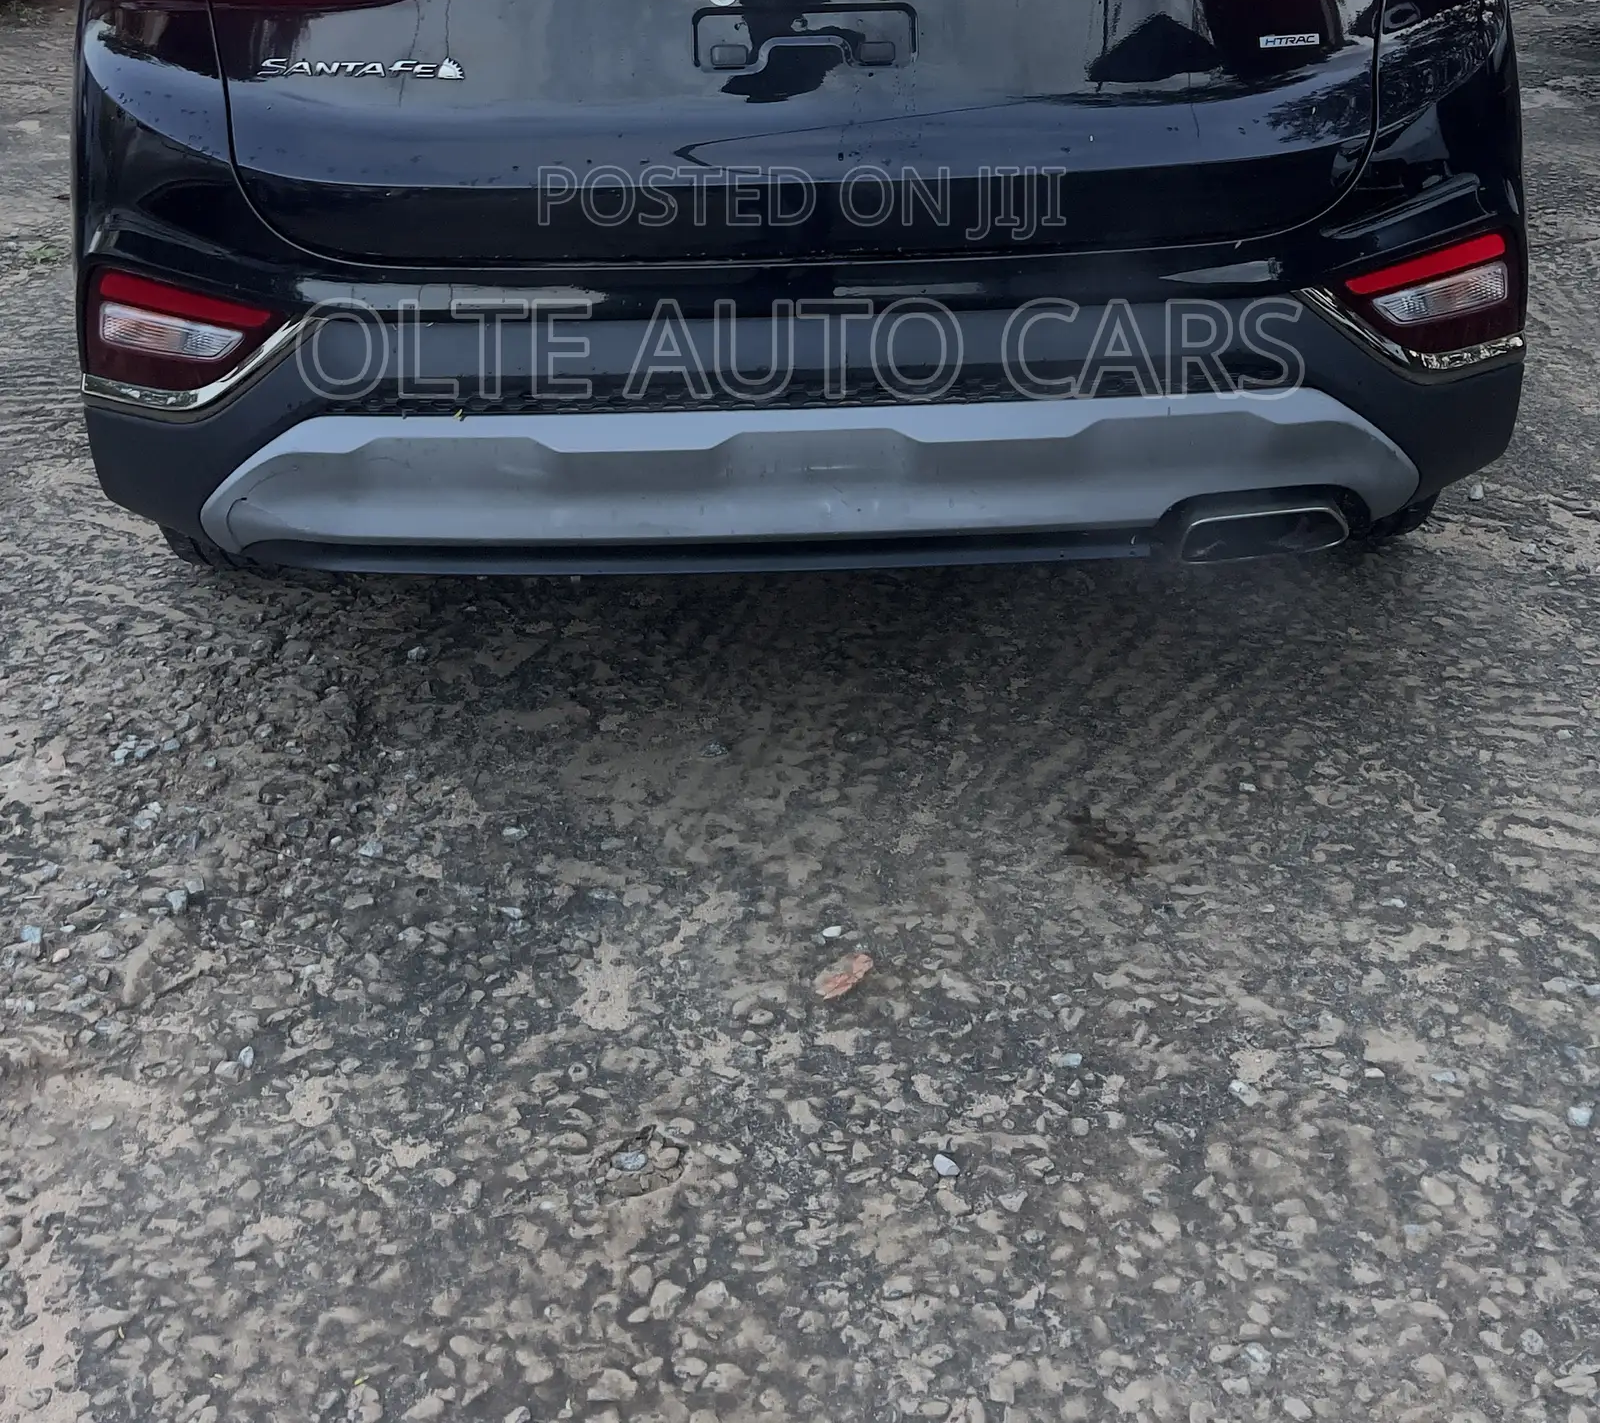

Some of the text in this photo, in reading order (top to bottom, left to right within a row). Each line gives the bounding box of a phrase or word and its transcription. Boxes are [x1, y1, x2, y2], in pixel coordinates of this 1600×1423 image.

[1264, 34, 1317, 46] HTRAC
[256, 57, 438, 78] SANTA FE
